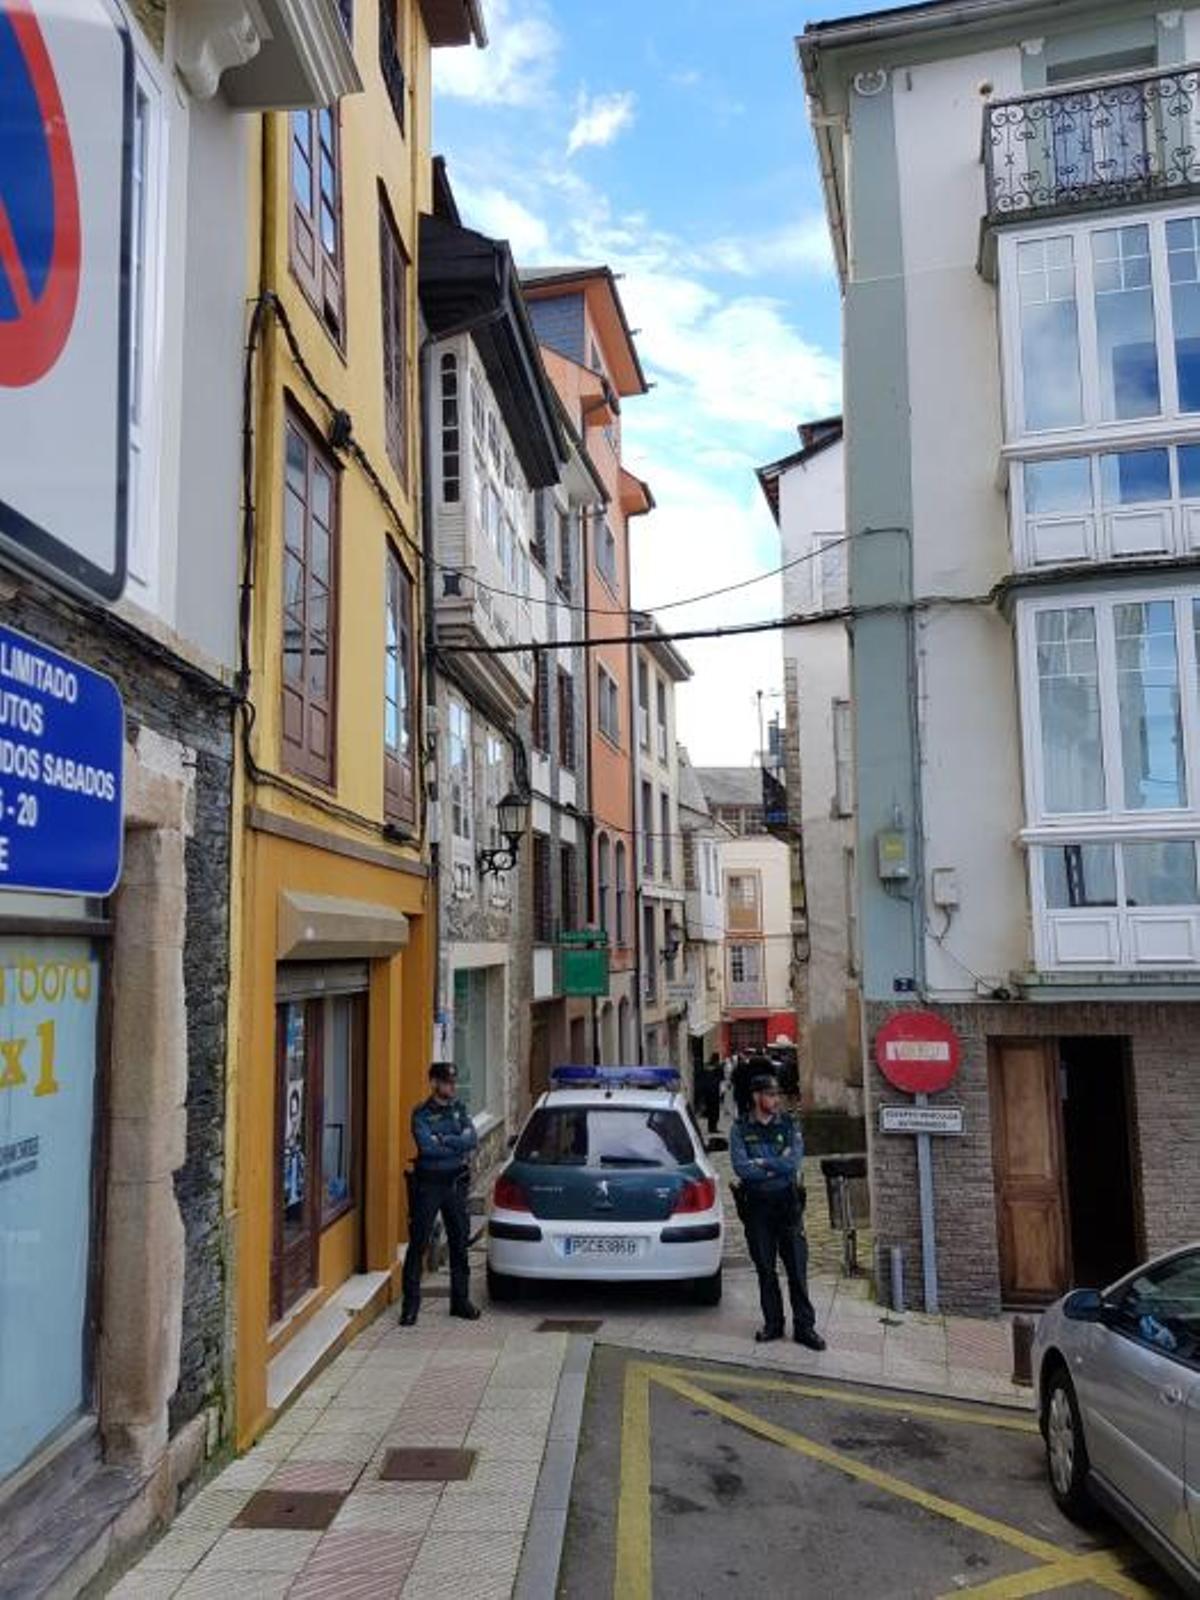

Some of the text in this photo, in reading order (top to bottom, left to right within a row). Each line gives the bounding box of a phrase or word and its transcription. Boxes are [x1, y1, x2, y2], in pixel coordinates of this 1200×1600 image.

[0, 641, 78, 704] LIMITADO
[42, 752, 115, 801] SABADOS
[17, 792, 38, 828] 20
